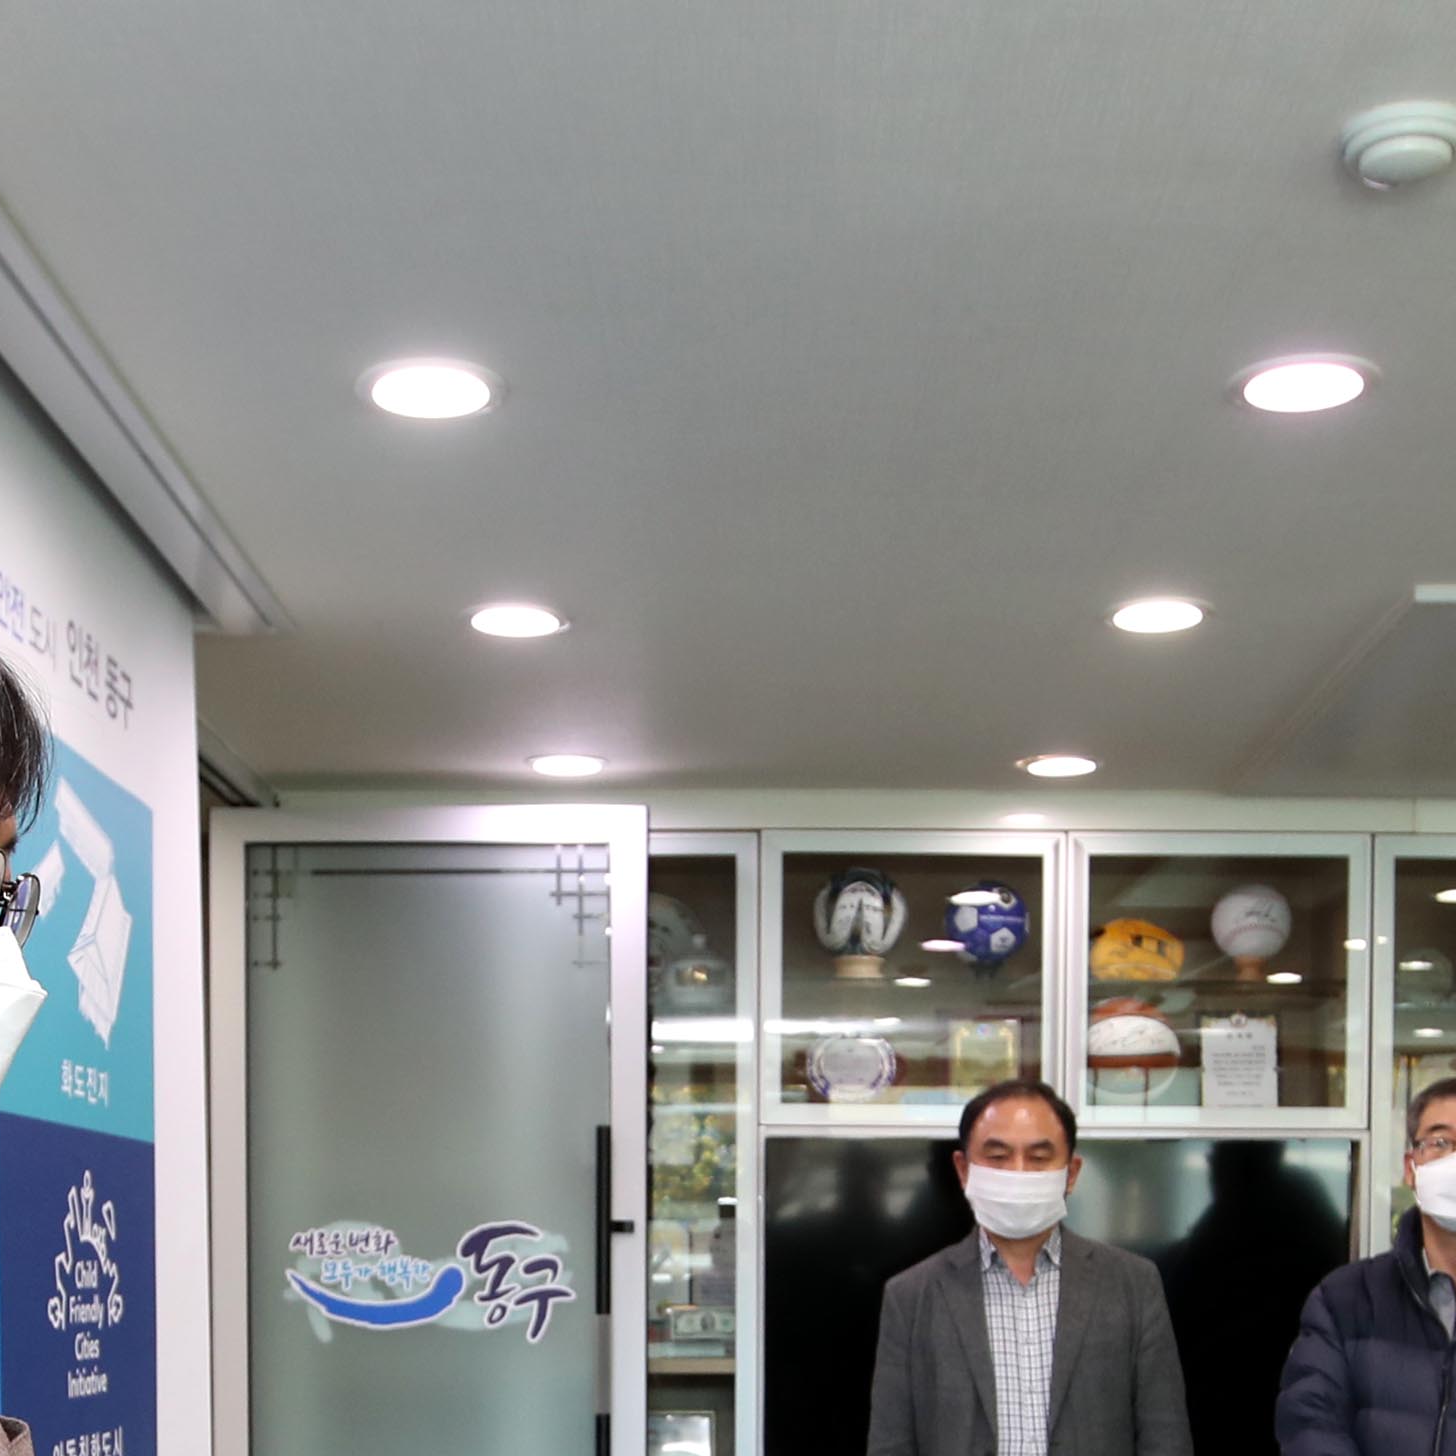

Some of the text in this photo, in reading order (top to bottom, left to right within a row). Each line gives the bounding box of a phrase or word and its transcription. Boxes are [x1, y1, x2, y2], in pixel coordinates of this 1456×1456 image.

[29, 604, 58, 674] 도시
[66, 619, 101, 702] 인천
[104, 654, 136, 731] 동구
[291, 1227, 397, 1257] 새로운 변화
[74, 1260, 98, 1290] Child
[321, 1257, 433, 1292] 모두가 행복한
[457, 1222, 575, 1342] 동구
[68, 1295, 105, 1330] Friendly
[74, 1331, 101, 1361] Cities
[67, 1365, 109, 1399] Initiative
